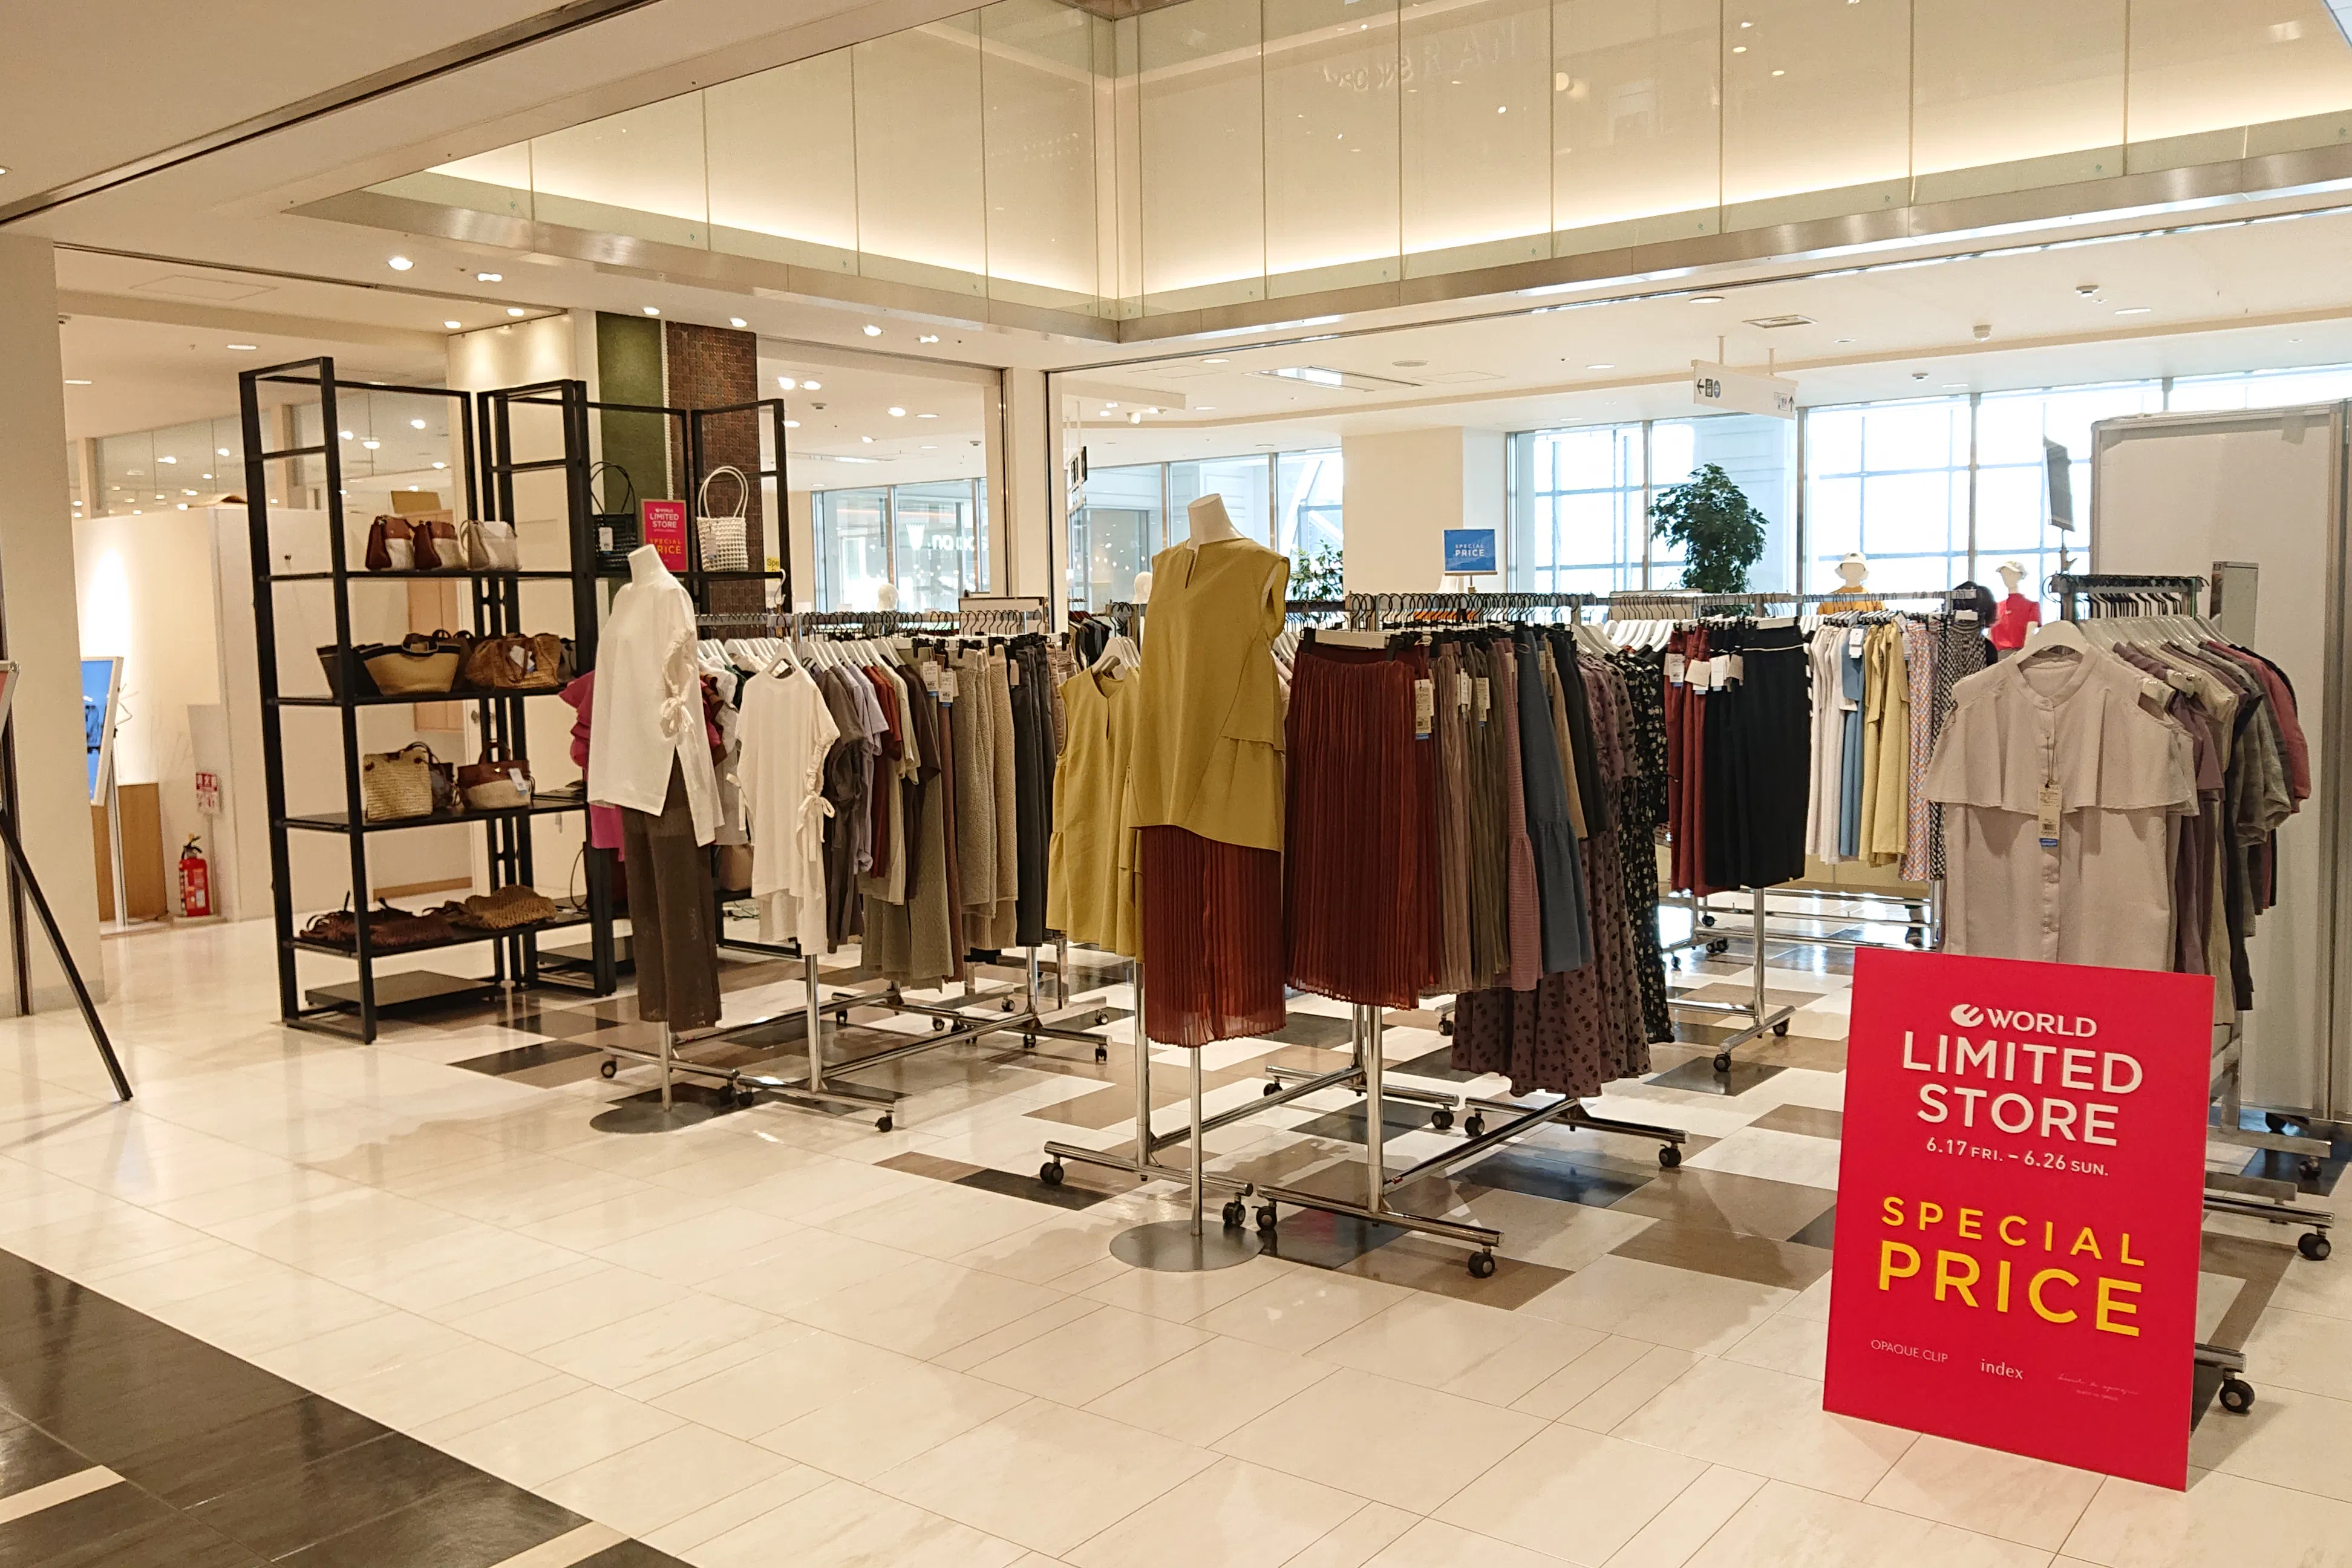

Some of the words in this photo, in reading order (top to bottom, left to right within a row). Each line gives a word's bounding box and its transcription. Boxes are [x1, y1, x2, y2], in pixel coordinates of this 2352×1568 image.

[656, 545, 682, 554] RICE
[1987, 1008, 2097, 1037] WORLD
[1903, 1030, 2143, 1094] LIMITED
[1917, 1083, 2118, 1146] STORE
[1926, 1137, 1967, 1156] 6.17
[1971, 1146, 2004, 1162] FRI.
[2024, 1150, 2066, 1171] 6.26
[2071, 1160, 2109, 1177] SUN.
[1881, 1196, 2145, 1267] SPECIAL
[1878, 1240, 2142, 1337] PRICE
[1981, 1358, 2024, 1379] index
